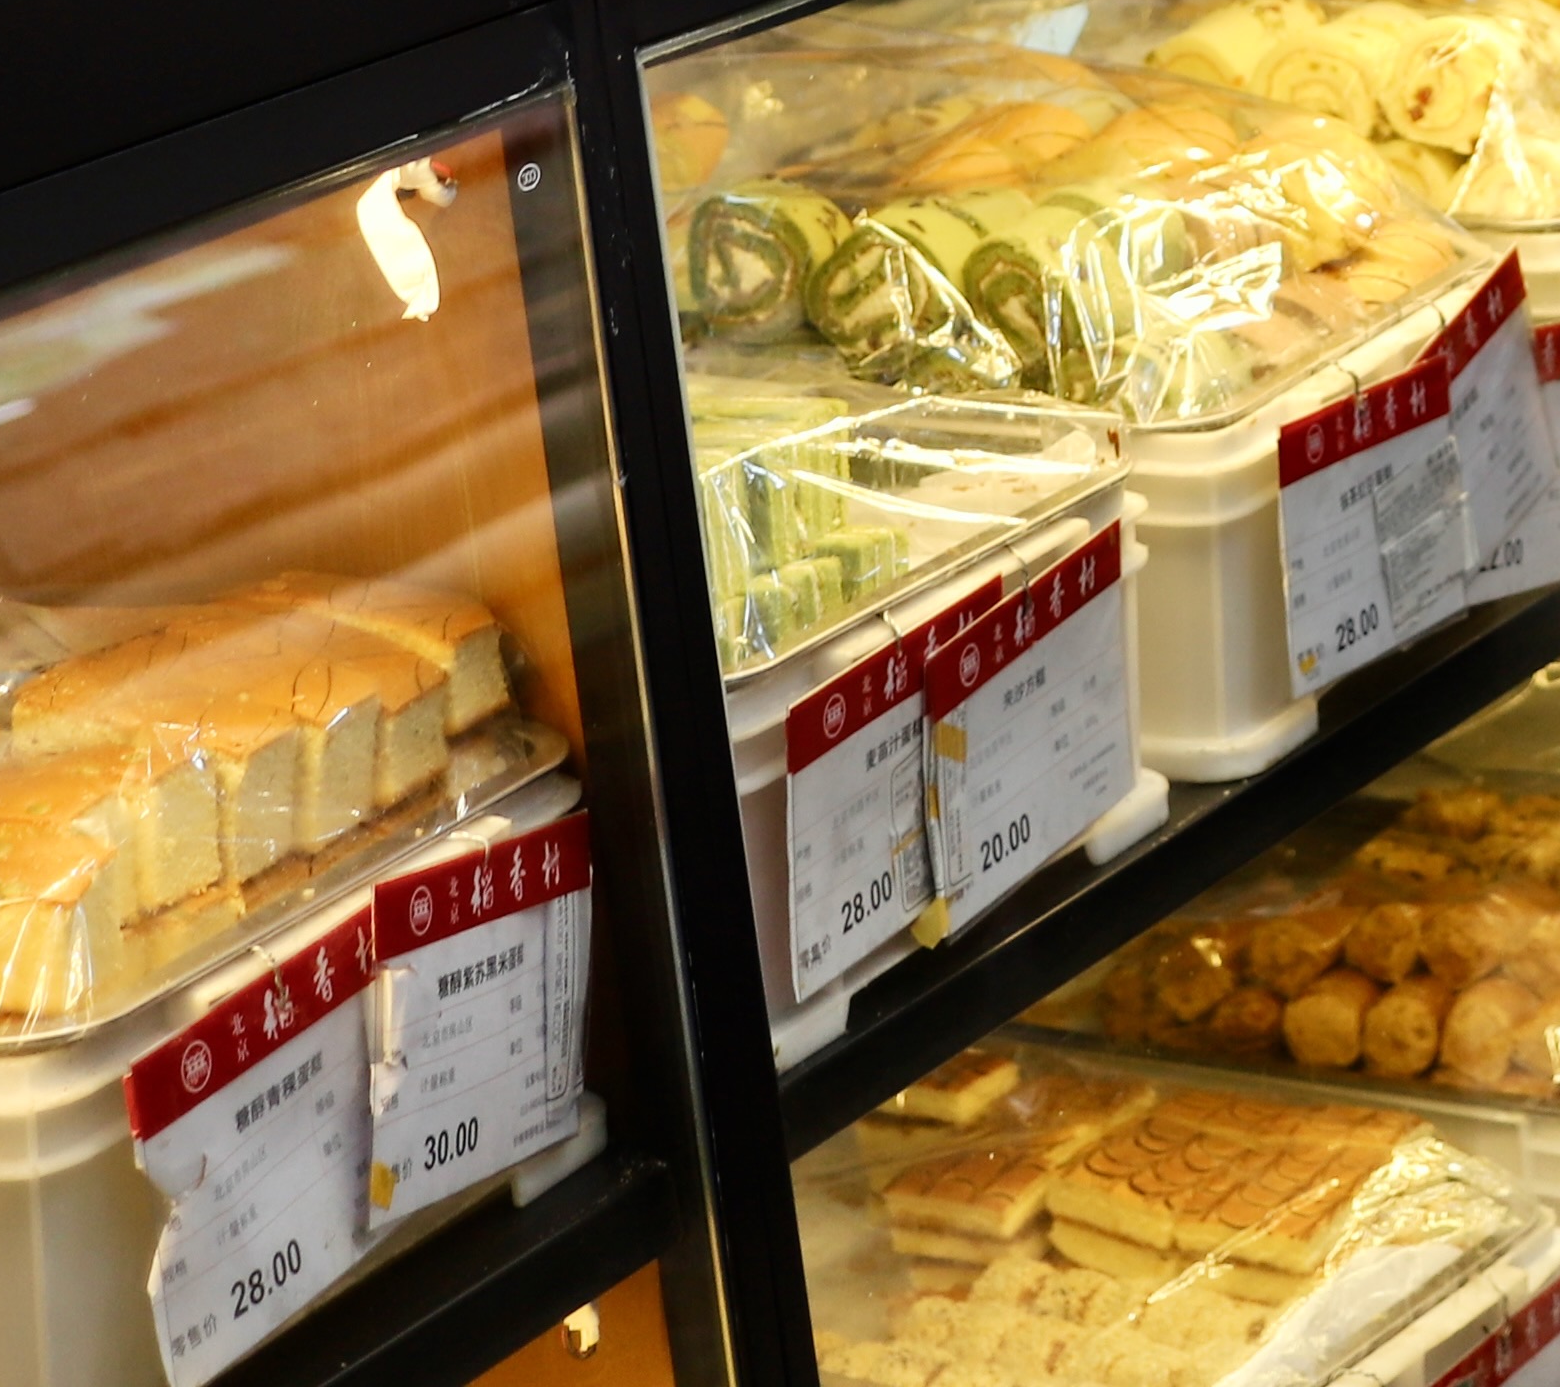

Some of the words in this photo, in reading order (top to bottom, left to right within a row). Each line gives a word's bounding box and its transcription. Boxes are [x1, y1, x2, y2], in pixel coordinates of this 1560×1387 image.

[1334, 603, 1380, 654] 28.00
[979, 812, 1031, 874] 20.00
[469, 839, 561, 920] 稻香村
[841, 868, 893, 936] 28.00
[424, 1116, 479, 1171] 30.00
[231, 1237, 302, 1321] 28.00
